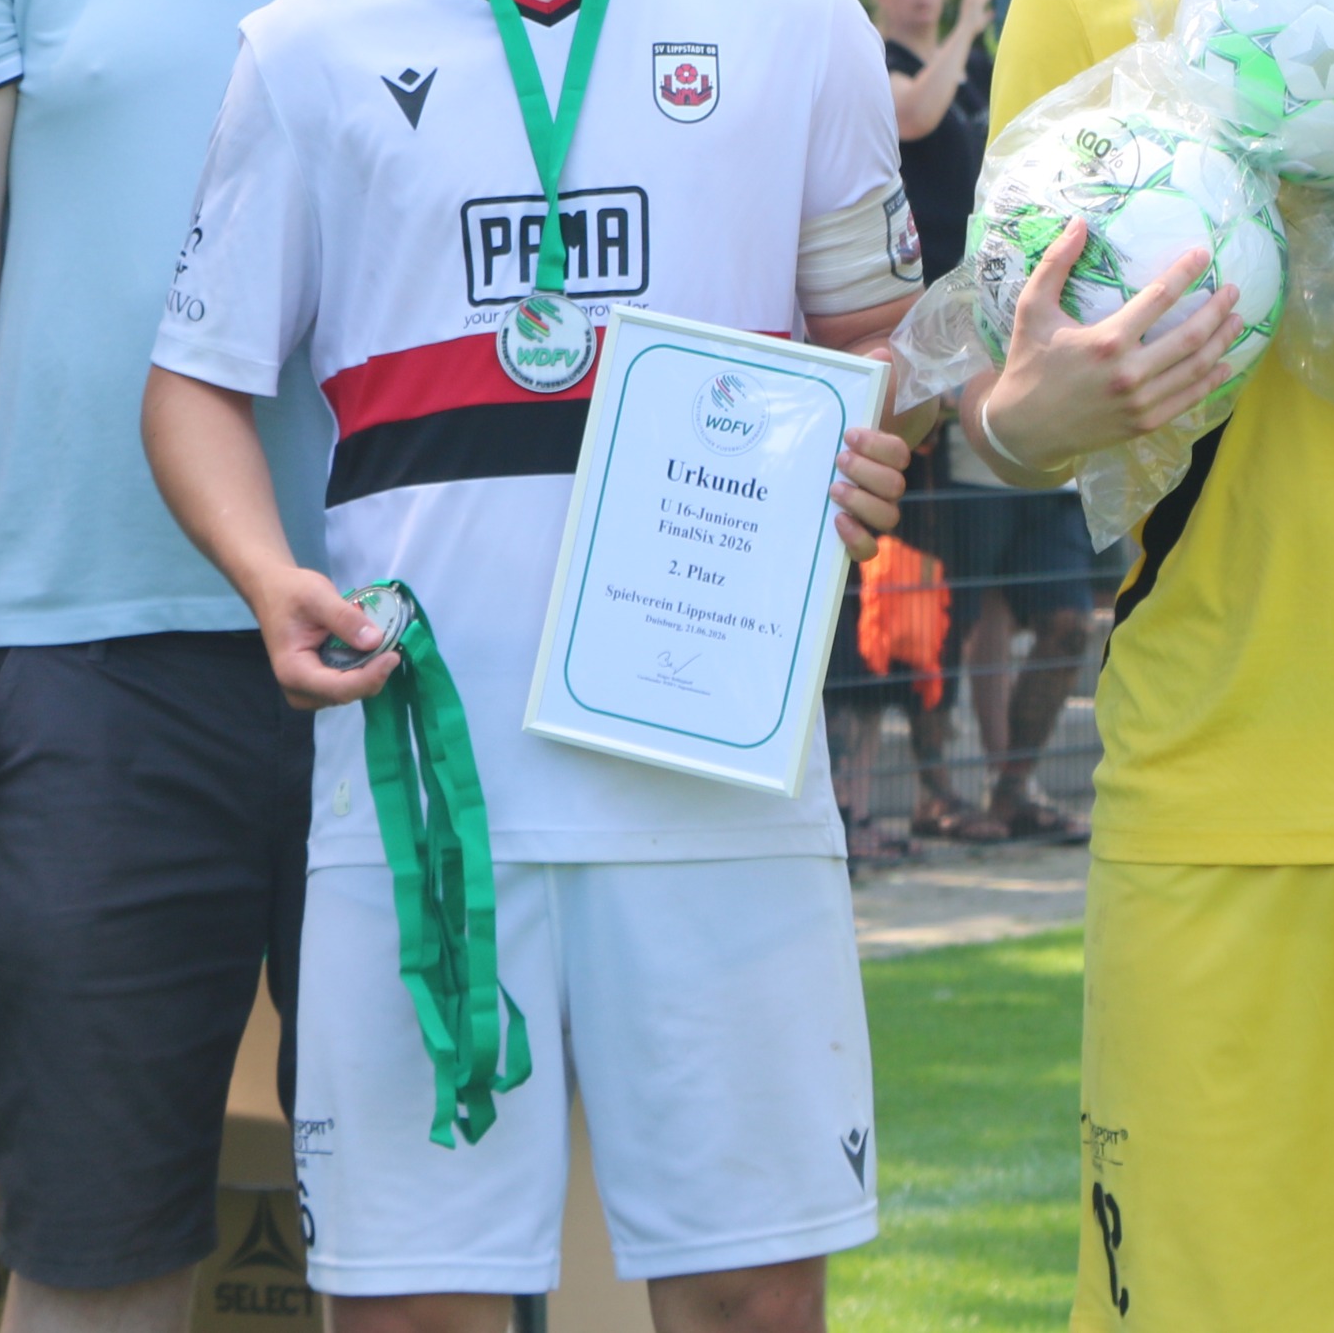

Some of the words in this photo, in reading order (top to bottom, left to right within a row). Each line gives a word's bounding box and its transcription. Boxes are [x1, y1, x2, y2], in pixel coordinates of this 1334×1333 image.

[667, 44, 705, 55] LIPPSTADT
[1076, 127, 1124, 169] 100%
[463, 309, 499, 329] your
[517, 347, 580, 368] WDFV
[706, 414, 754, 436] WDFV
[667, 458, 769, 501] Urkunde
[660, 498, 672, 513] U
[677, 502, 759, 533] 16-Junioren
[658, 519, 715, 545] FinalSix
[719, 533, 753, 553] 2026
[668, 560, 681, 576] 2.
[686, 564, 726, 587] Platz
[605, 584, 673, 611] Spielverein
[676, 601, 737, 627] Lippstadt
[740, 616, 755, 631] 08
[758, 623, 783, 638] e.V.
[645, 614, 684, 632] Duisburg,
[214, 1283, 314, 1315] SELECT
